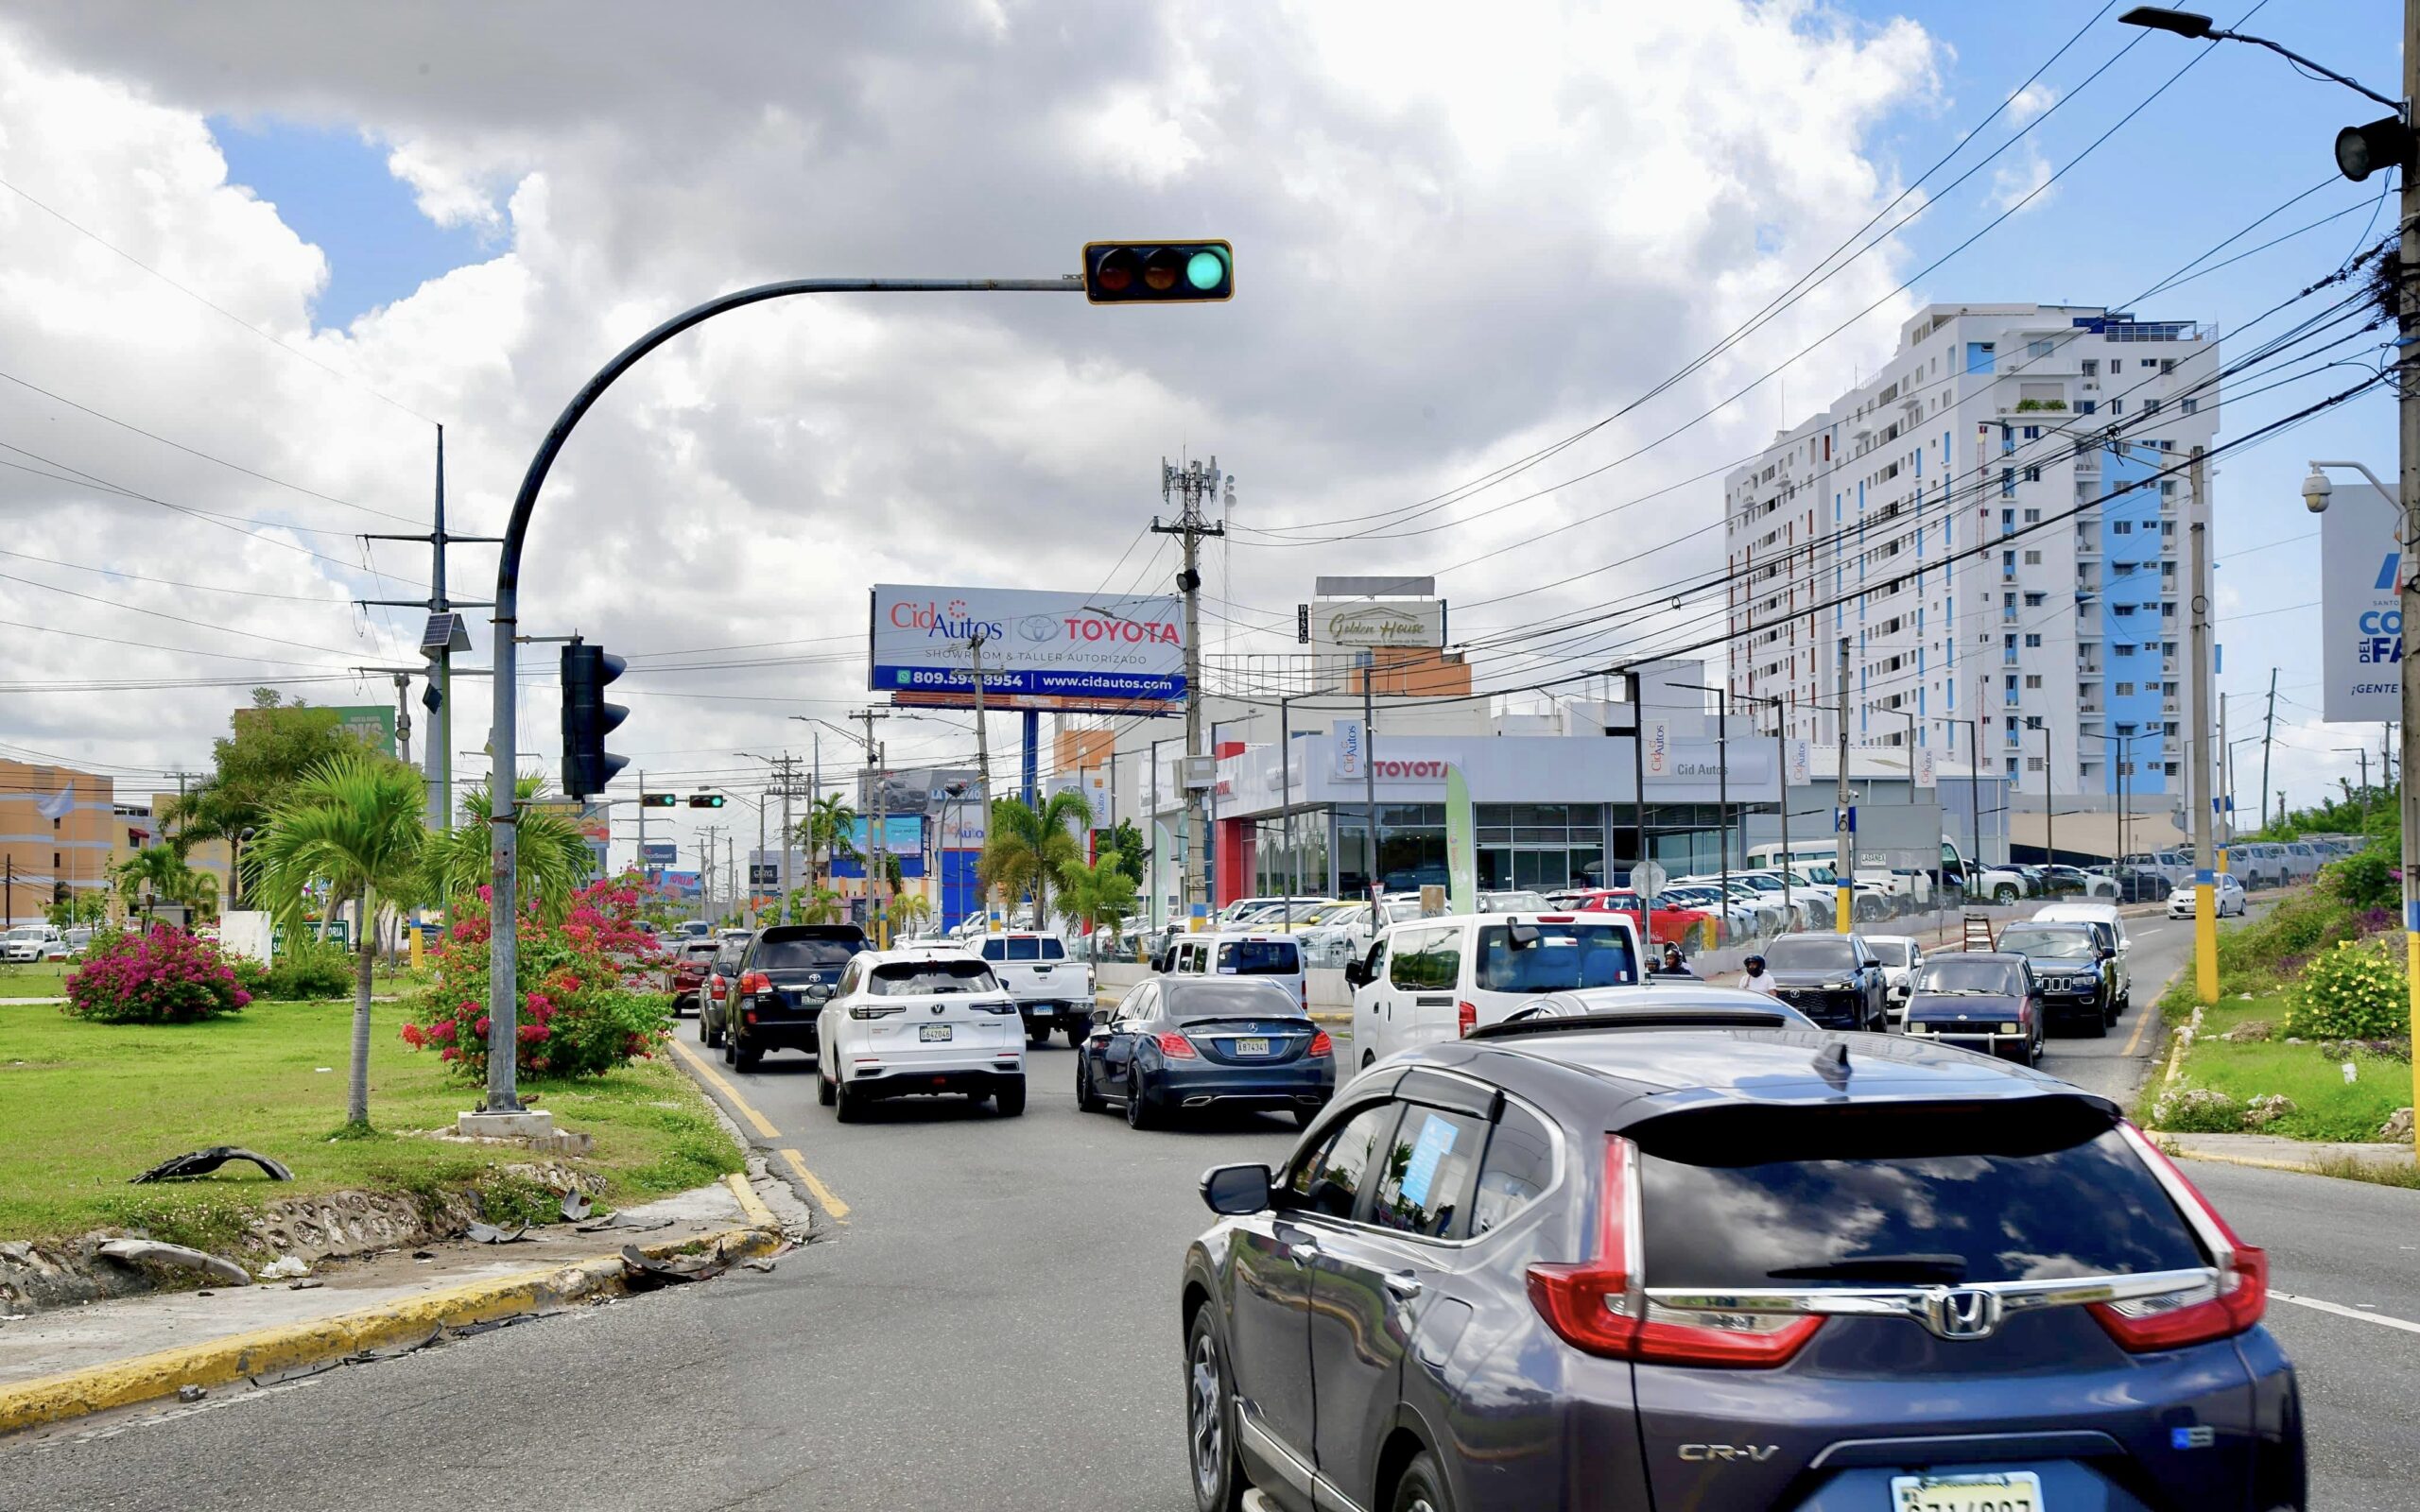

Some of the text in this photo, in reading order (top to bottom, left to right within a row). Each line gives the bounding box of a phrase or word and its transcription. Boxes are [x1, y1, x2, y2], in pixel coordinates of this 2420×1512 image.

[1064, 618, 1181, 644] TOYOTA
[1299, 605, 1308, 644] DISCO
[1328, 612, 1426, 638] Golden House
[925, 649, 1147, 665] SHOWROM & TALLER AUTORIZADO
[2359, 637, 2371, 663] DEL
[1043, 676, 1172, 690] www.cidautos.com
[2351, 682, 2399, 696] ¡GENTE
[1677, 764, 1695, 776] Cid
[1678, 1444, 1780, 1461] CR-V
